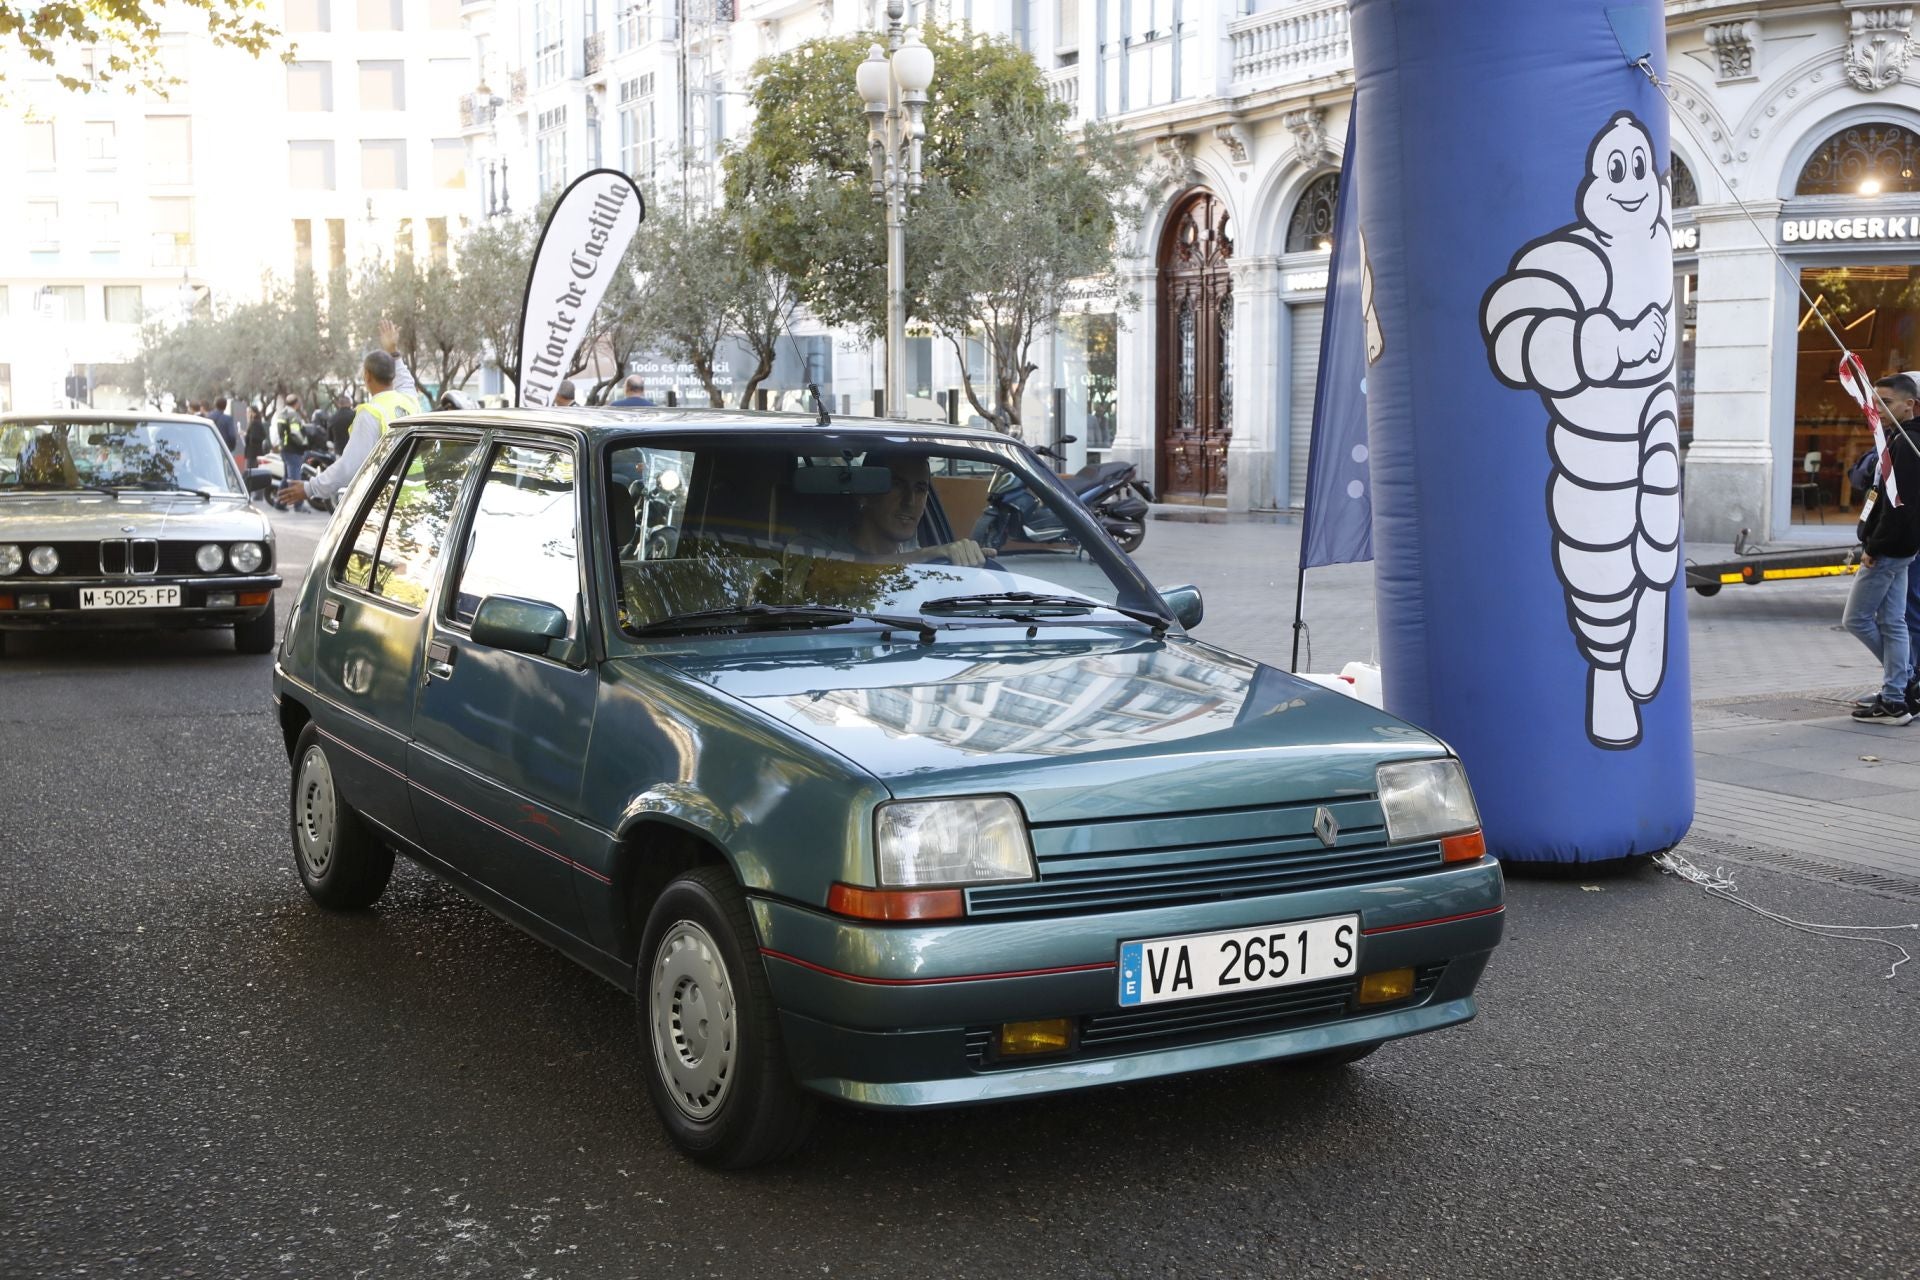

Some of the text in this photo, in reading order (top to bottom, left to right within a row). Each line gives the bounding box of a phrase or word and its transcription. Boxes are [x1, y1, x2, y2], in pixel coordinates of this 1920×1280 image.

[1672, 228, 1697, 249] NG
[1782, 217, 1920, 242] BURGER KI
[523, 183, 630, 407] El Norte de Castilla
[630, 361, 658, 373] Todo
[1147, 925, 1353, 994] VA 2651 S
[1126, 981, 1136, 995] E
